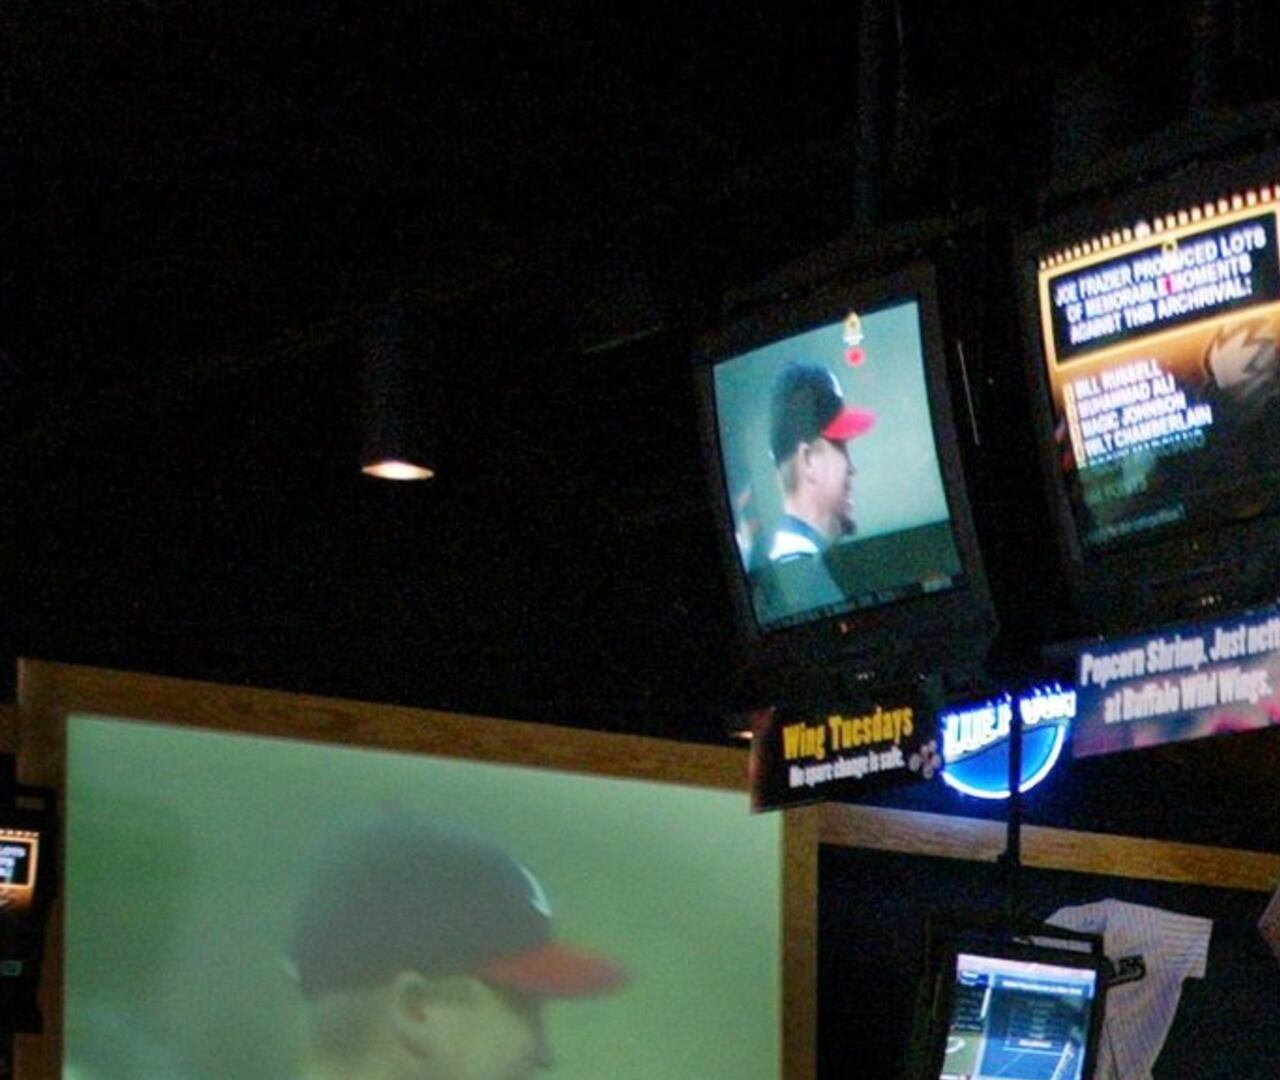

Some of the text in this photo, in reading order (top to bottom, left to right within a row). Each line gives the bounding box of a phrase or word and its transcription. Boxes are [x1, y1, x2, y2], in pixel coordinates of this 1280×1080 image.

[1134, 239, 1218, 282] PRODUCED
[1221, 225, 1266, 254] LOTS
[1066, 303, 1082, 323] OF
[1171, 253, 1253, 291] MOMENTS
[1080, 649, 1145, 688] Popcorn
[1210, 624, 1246, 661] Just
[1103, 690, 1121, 724] at
[1122, 679, 1180, 721] Buffalo
[1181, 671, 1217, 711] Wild
[783, 722, 826, 760] Wing
[828, 705, 914, 751] Tuesdays
